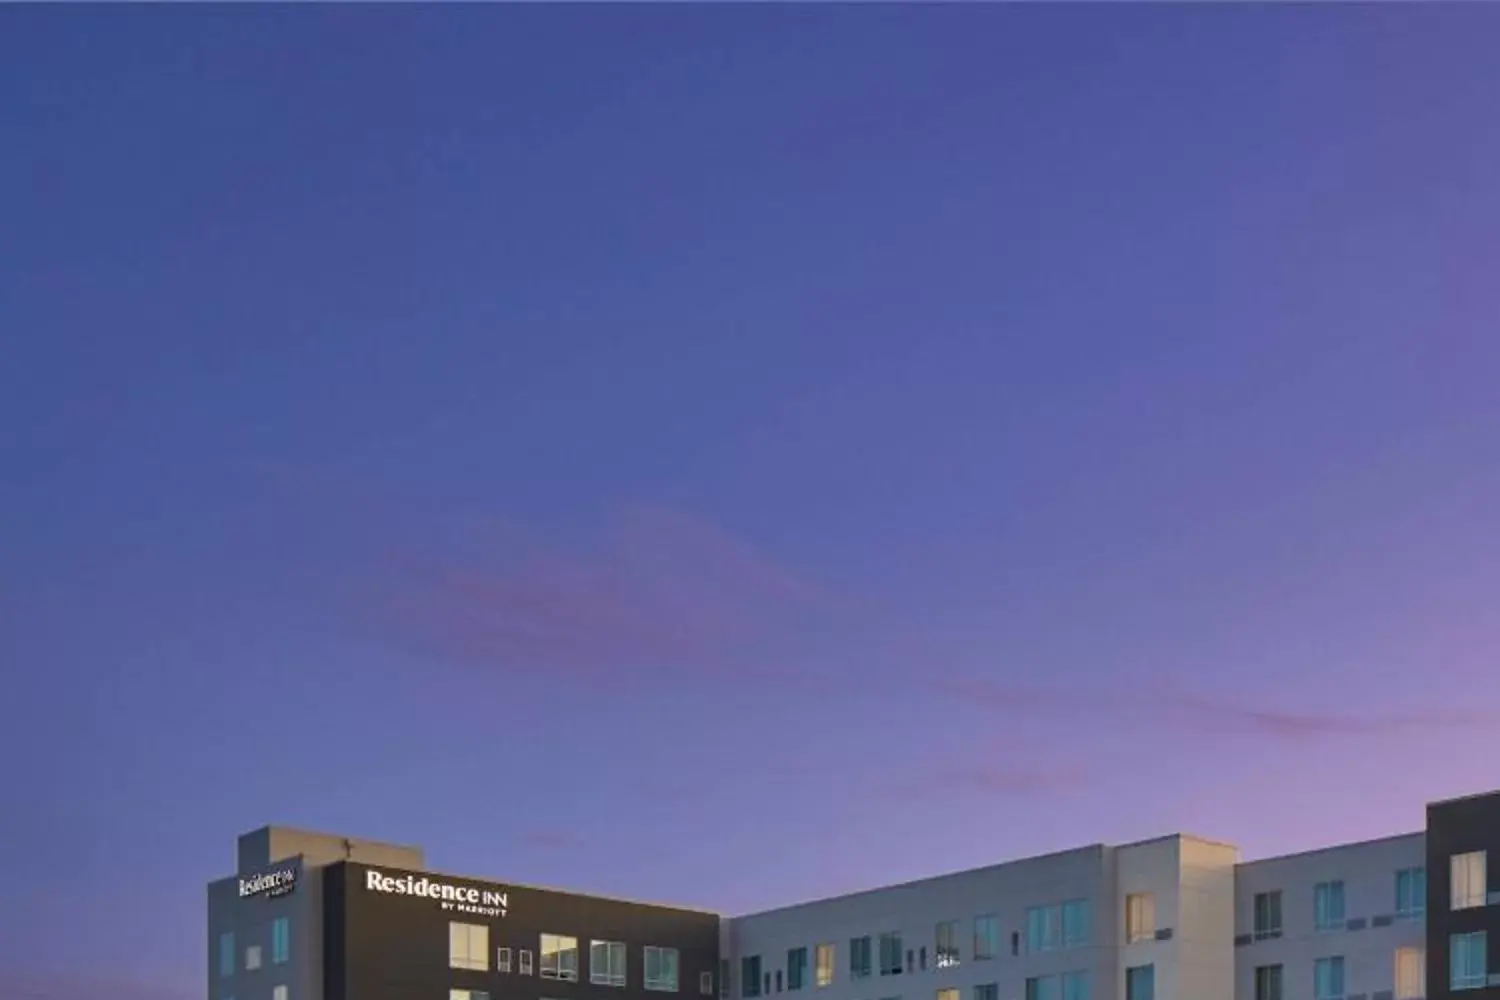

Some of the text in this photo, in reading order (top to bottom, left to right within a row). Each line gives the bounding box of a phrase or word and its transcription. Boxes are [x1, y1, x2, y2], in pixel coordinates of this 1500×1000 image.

[366, 870, 508, 908] Residence INN
[441, 901, 454, 911] BY
